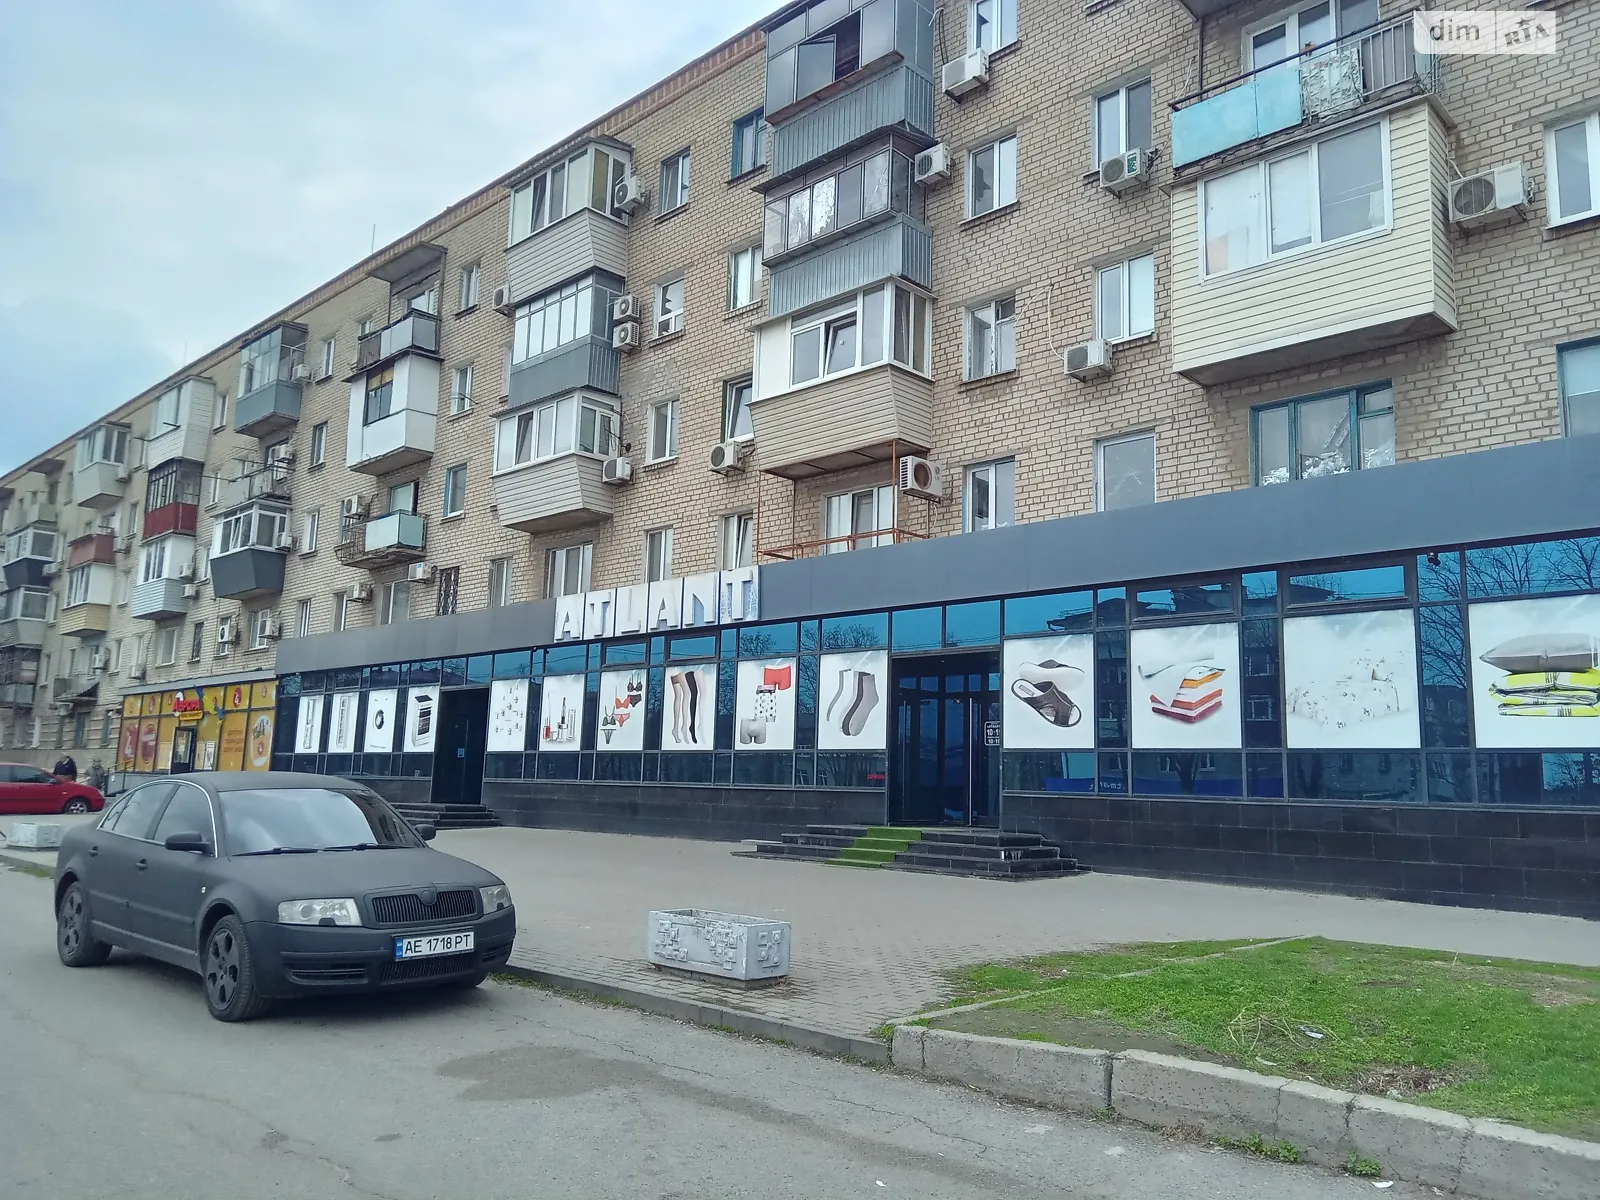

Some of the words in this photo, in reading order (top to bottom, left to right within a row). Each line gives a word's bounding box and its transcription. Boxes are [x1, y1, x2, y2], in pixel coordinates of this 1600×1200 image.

[554, 568, 756, 642] ATLANT
[404, 939, 423, 955] AE
[426, 936, 452, 952] 1718
[454, 933, 471, 949] PT
